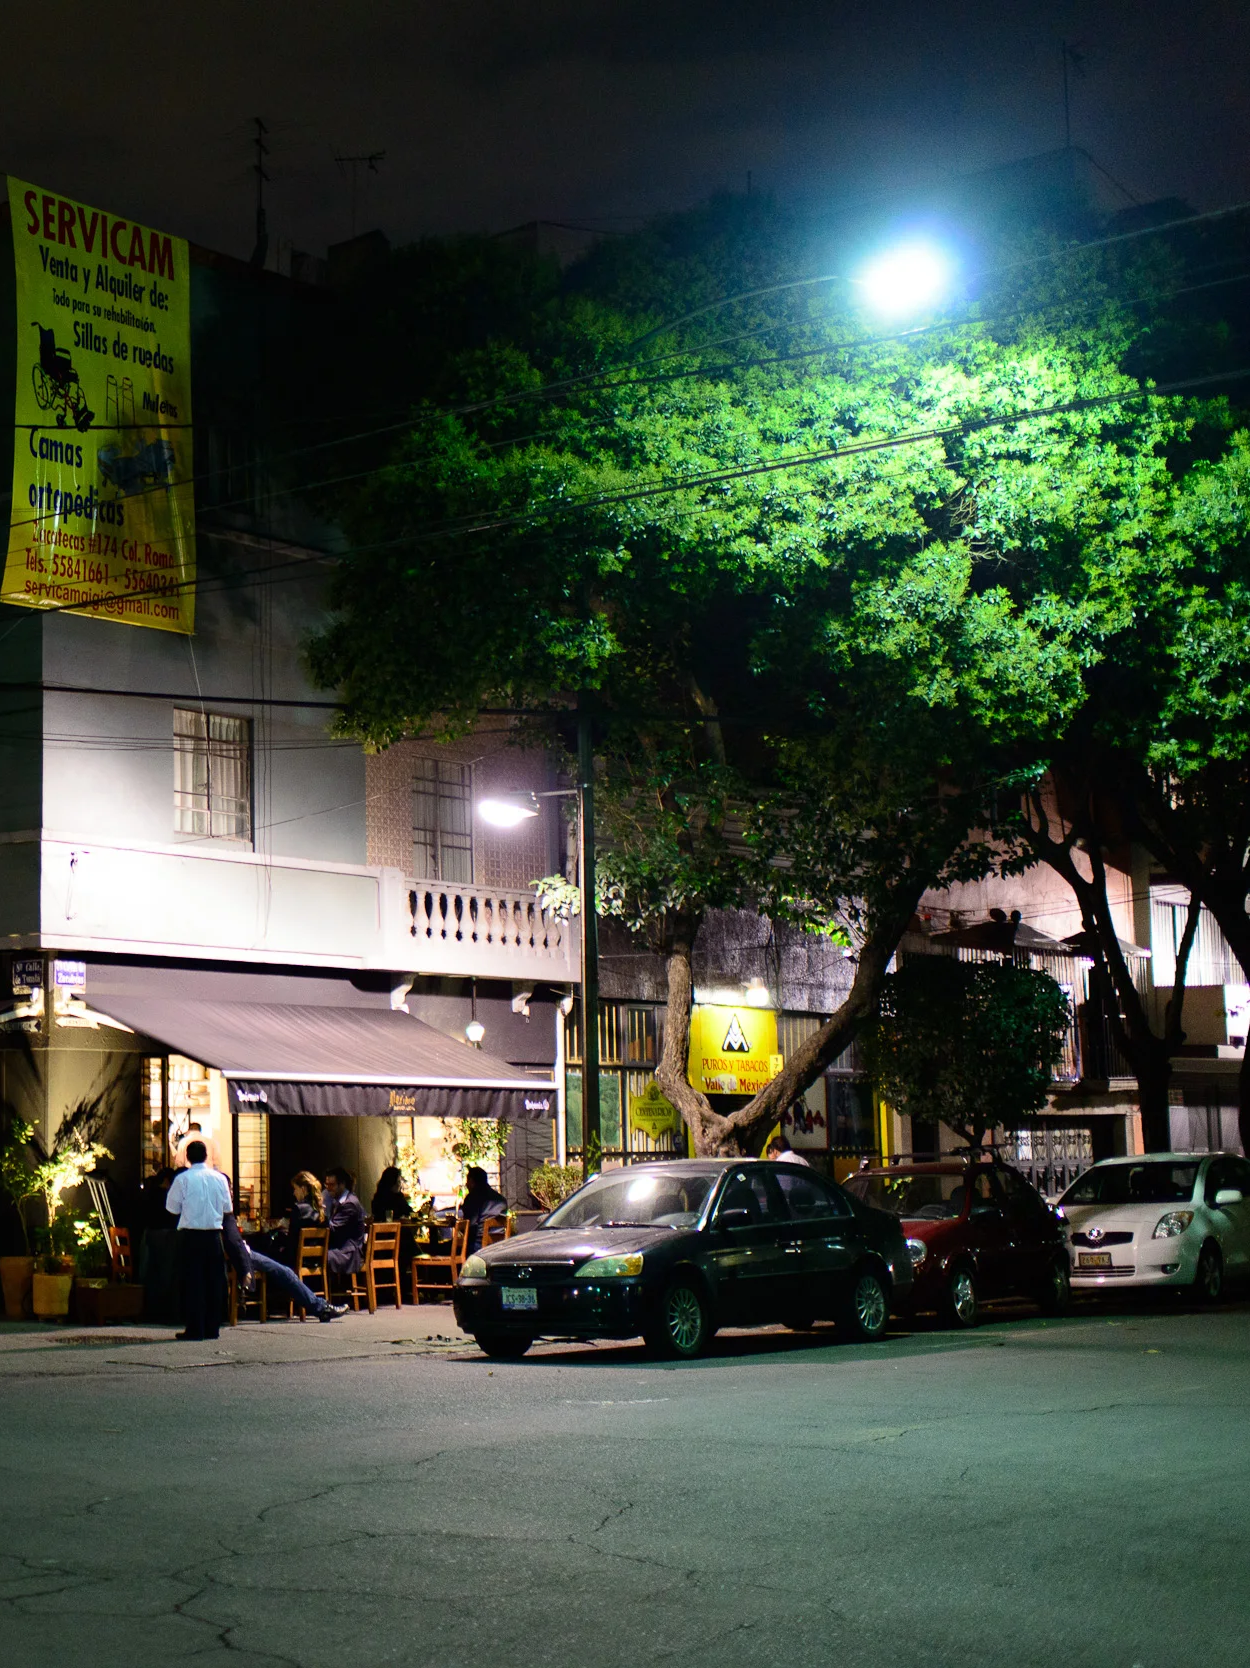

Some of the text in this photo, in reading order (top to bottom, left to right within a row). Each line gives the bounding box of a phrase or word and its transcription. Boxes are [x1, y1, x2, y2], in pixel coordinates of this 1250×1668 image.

[24, 190, 175, 281] SERVICAM
[39, 244, 169, 312] Venta y Alquiler de:
[52, 287, 70, 308] Todo
[72, 298, 91, 314] para
[93, 303, 102, 317] su
[73, 320, 174, 375] Sillas de ruedas
[29, 426, 83, 469] Camas
[28, 482, 125, 527] ortopédicas
[25, 548, 47, 574] Tels.
[88, 532, 118, 558] #174
[121, 539, 141, 563] Col.
[701, 1058, 728, 1071] PUROS
[736, 1060, 769, 1073] TABACOS
